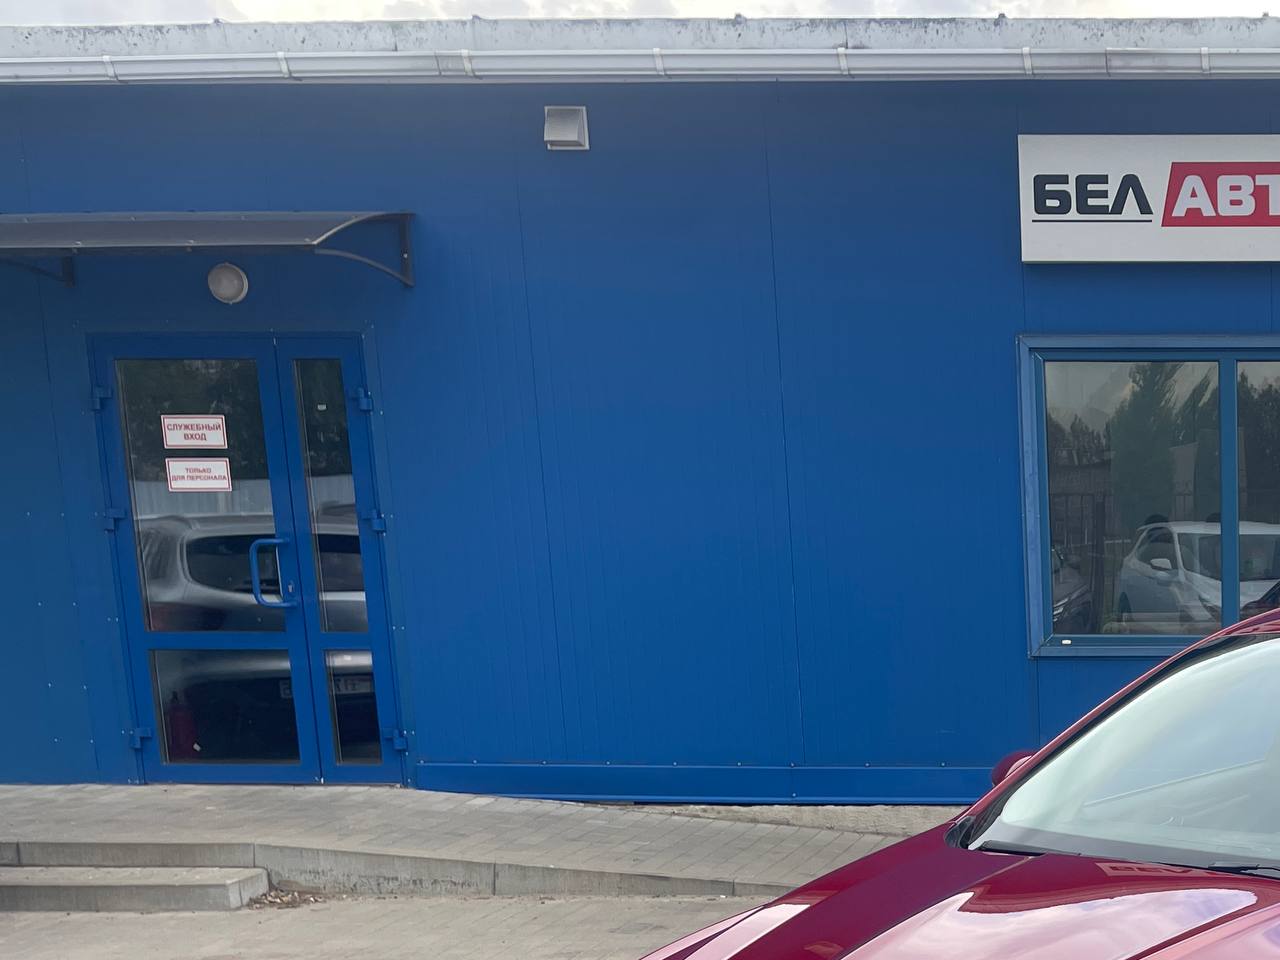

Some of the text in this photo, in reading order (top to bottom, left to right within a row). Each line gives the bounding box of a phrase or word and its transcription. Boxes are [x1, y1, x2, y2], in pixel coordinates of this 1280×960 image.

[1032, 173, 1154, 217] БЕЛ
[167, 422, 222, 432] СЛУЖЕБНЫЙ
[184, 433, 207, 441] ВХОД
